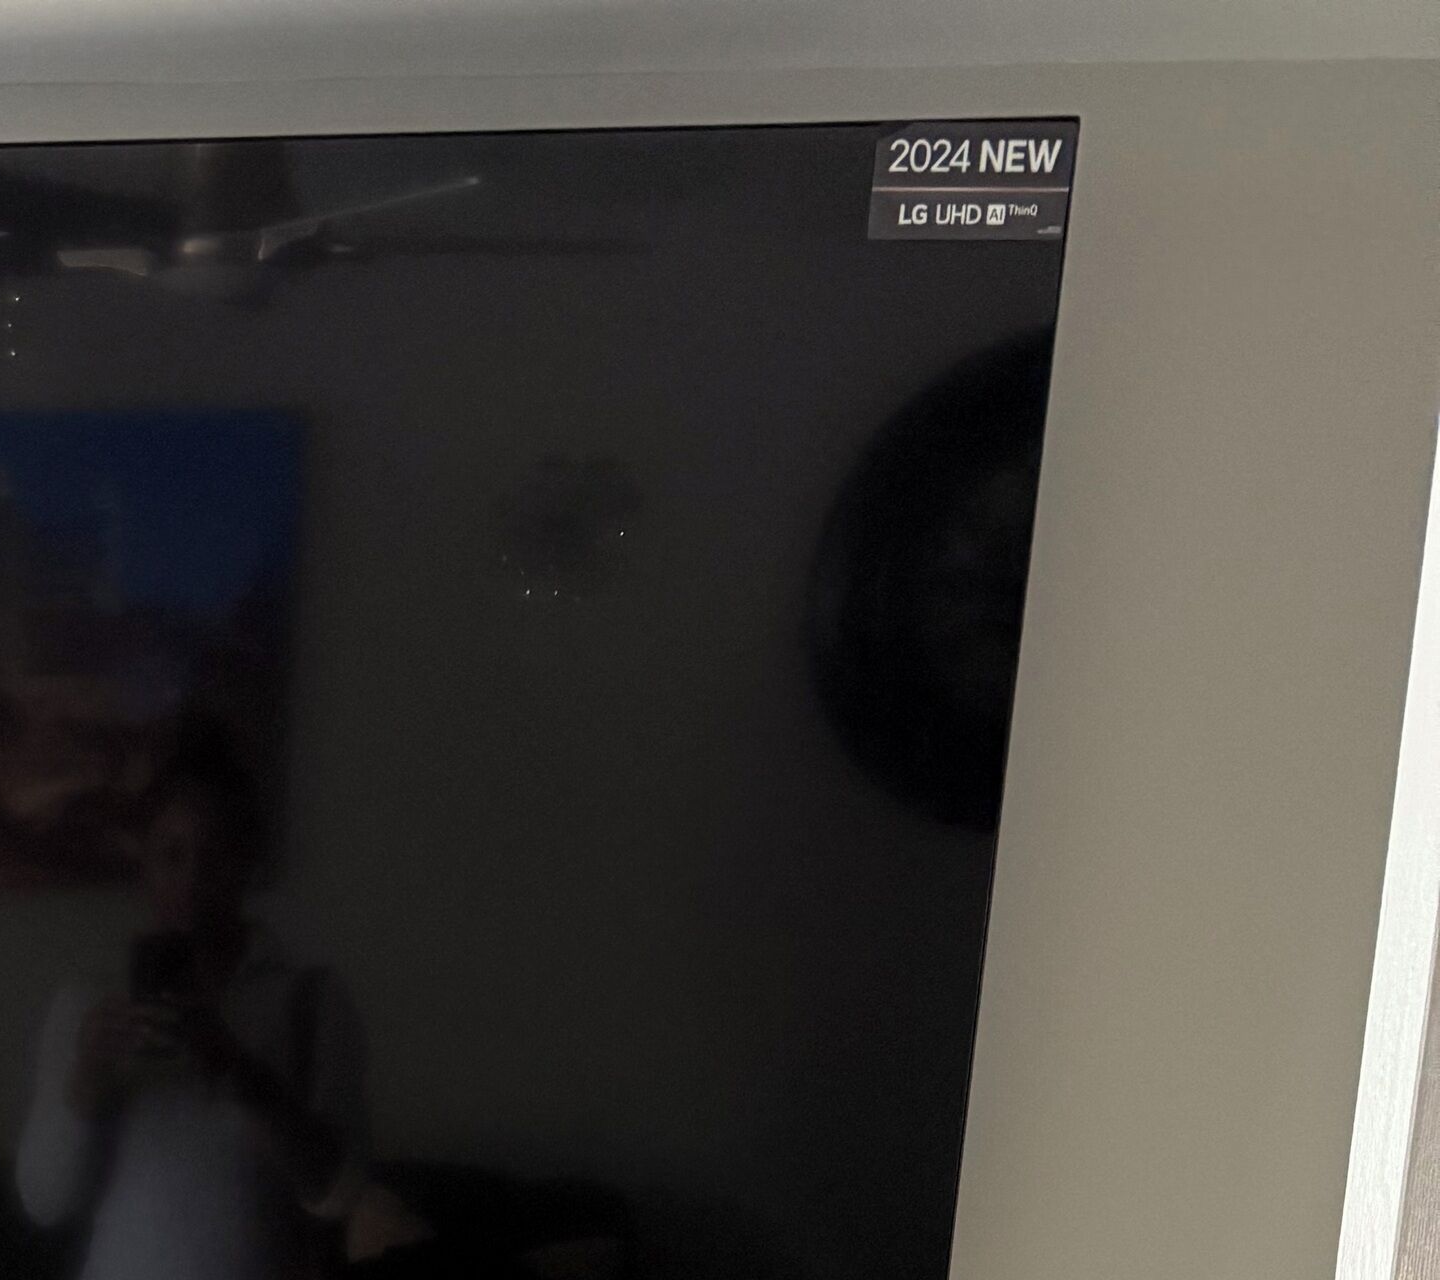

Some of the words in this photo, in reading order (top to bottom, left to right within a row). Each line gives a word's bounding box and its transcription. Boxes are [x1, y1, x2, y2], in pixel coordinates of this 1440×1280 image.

[888, 138, 971, 173] 2024
[979, 139, 1063, 173] NEW
[898, 204, 928, 225] LG
[935, 204, 982, 225] UHD
[987, 205, 1006, 224] AI
[1008, 204, 1038, 217] ThinQ
